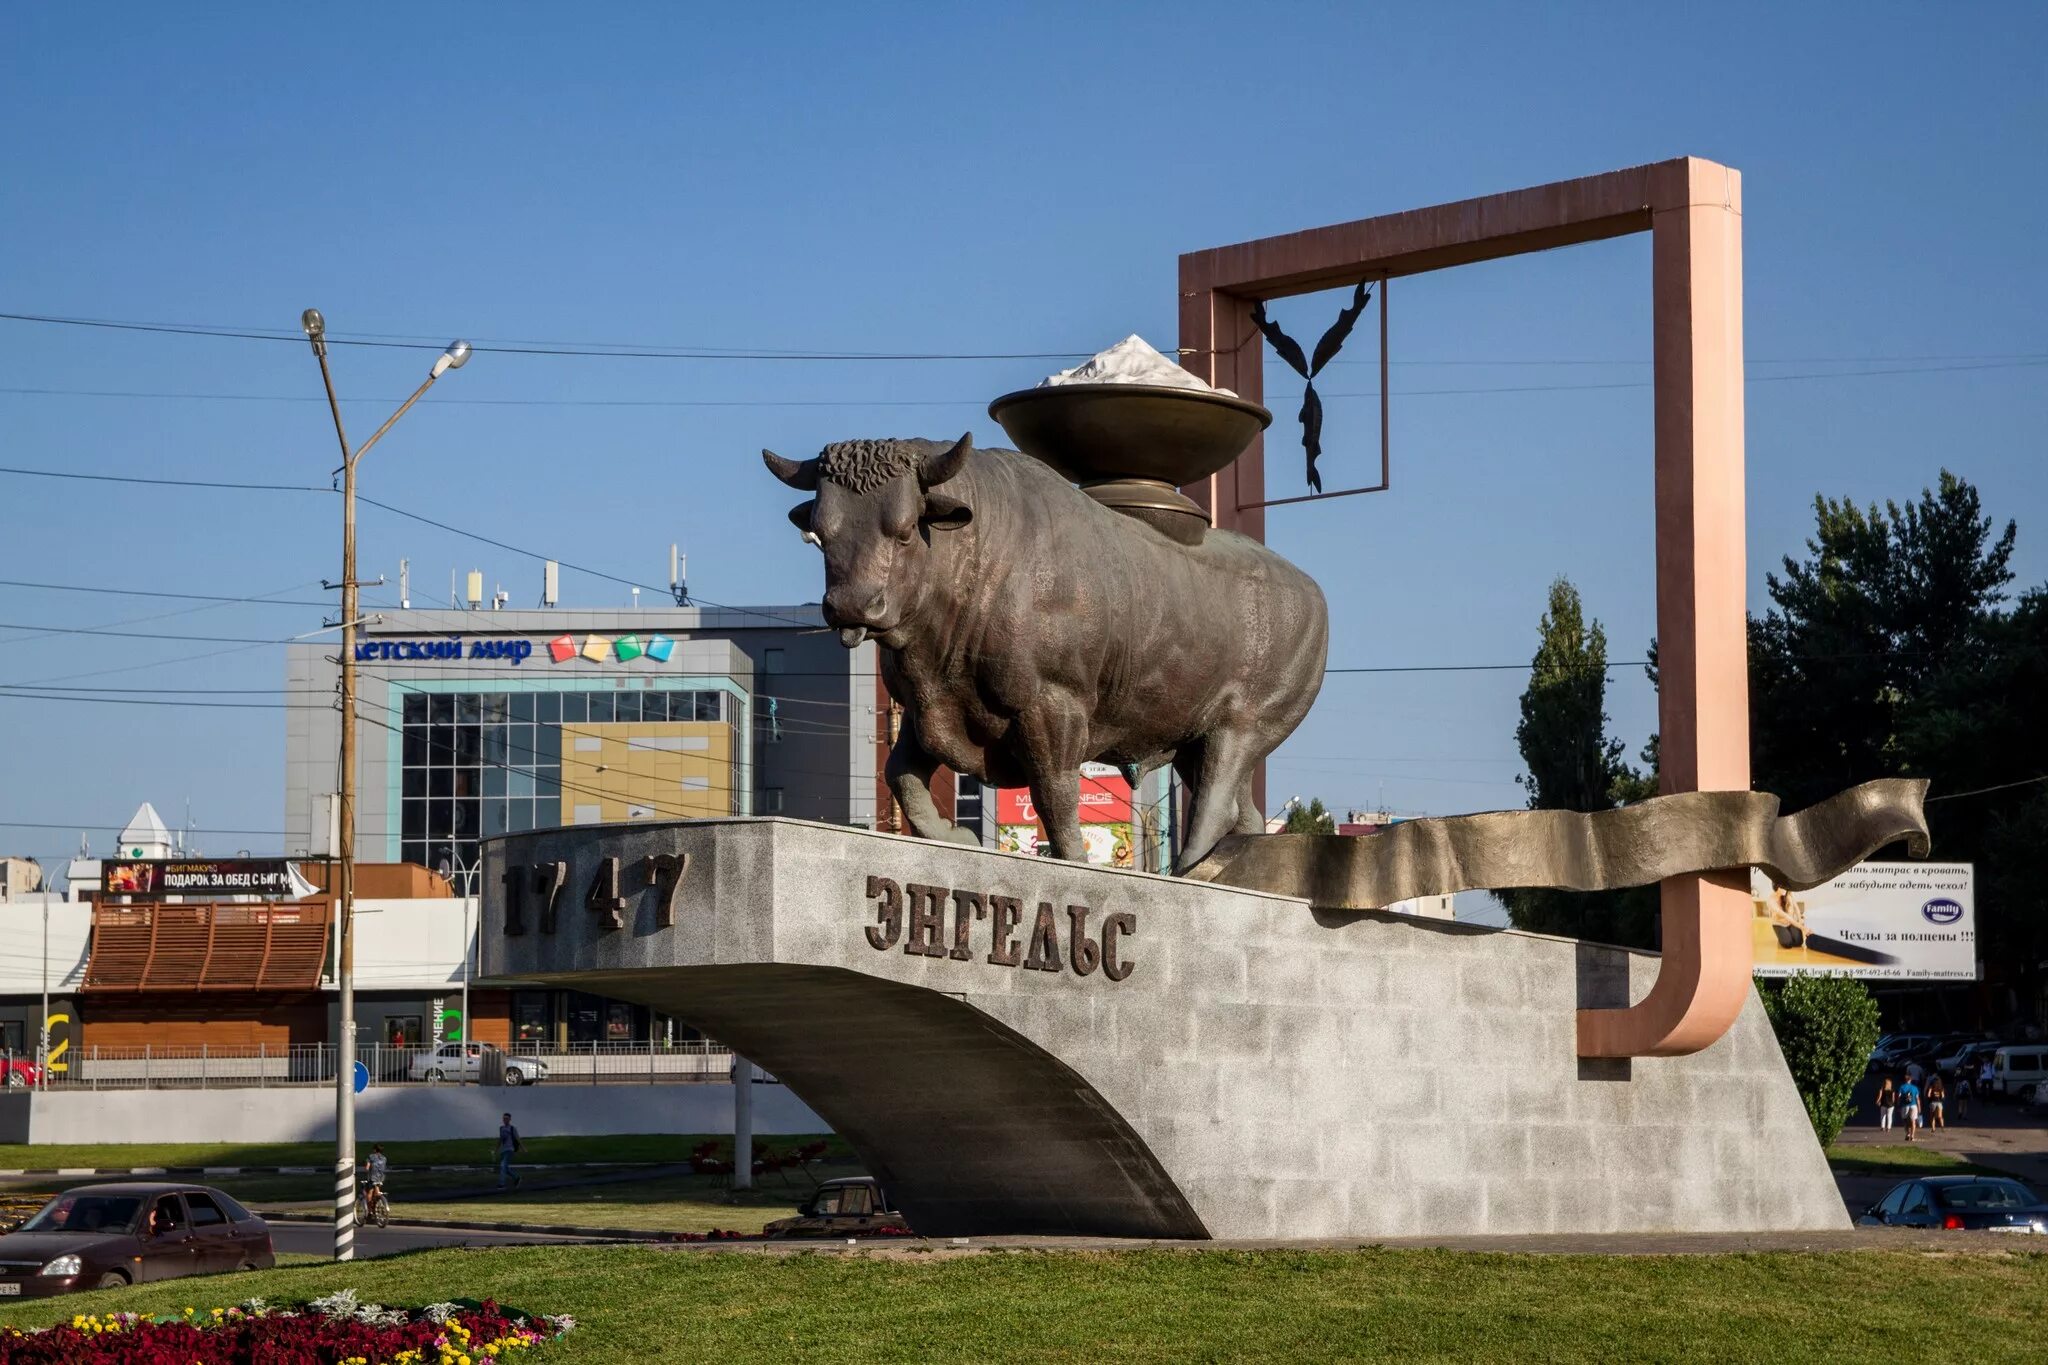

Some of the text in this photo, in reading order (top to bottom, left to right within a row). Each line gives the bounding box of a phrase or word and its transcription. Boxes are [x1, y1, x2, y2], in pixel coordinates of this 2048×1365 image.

[469, 640, 532, 666] мир
[1870, 866, 1911, 877] матрас
[1913, 867, 1919, 875] в
[1921, 866, 1969, 877] кровать,
[164, 873, 209, 887] ПОДАРОК
[211, 873, 224, 886] ЗА
[225, 873, 251, 887] ОБЕД
[252, 873, 259, 885] С
[260, 872, 279, 885] БИГ
[1834, 880, 1968, 891] не забудьте одеть чехол!
[502, 853, 690, 937] 1747
[1926, 903, 1959, 915] Family
[864, 875, 1137, 982] ЭНГЕЛЬС
[1840, 930, 1974, 943] Чехлы за полцены !!!
